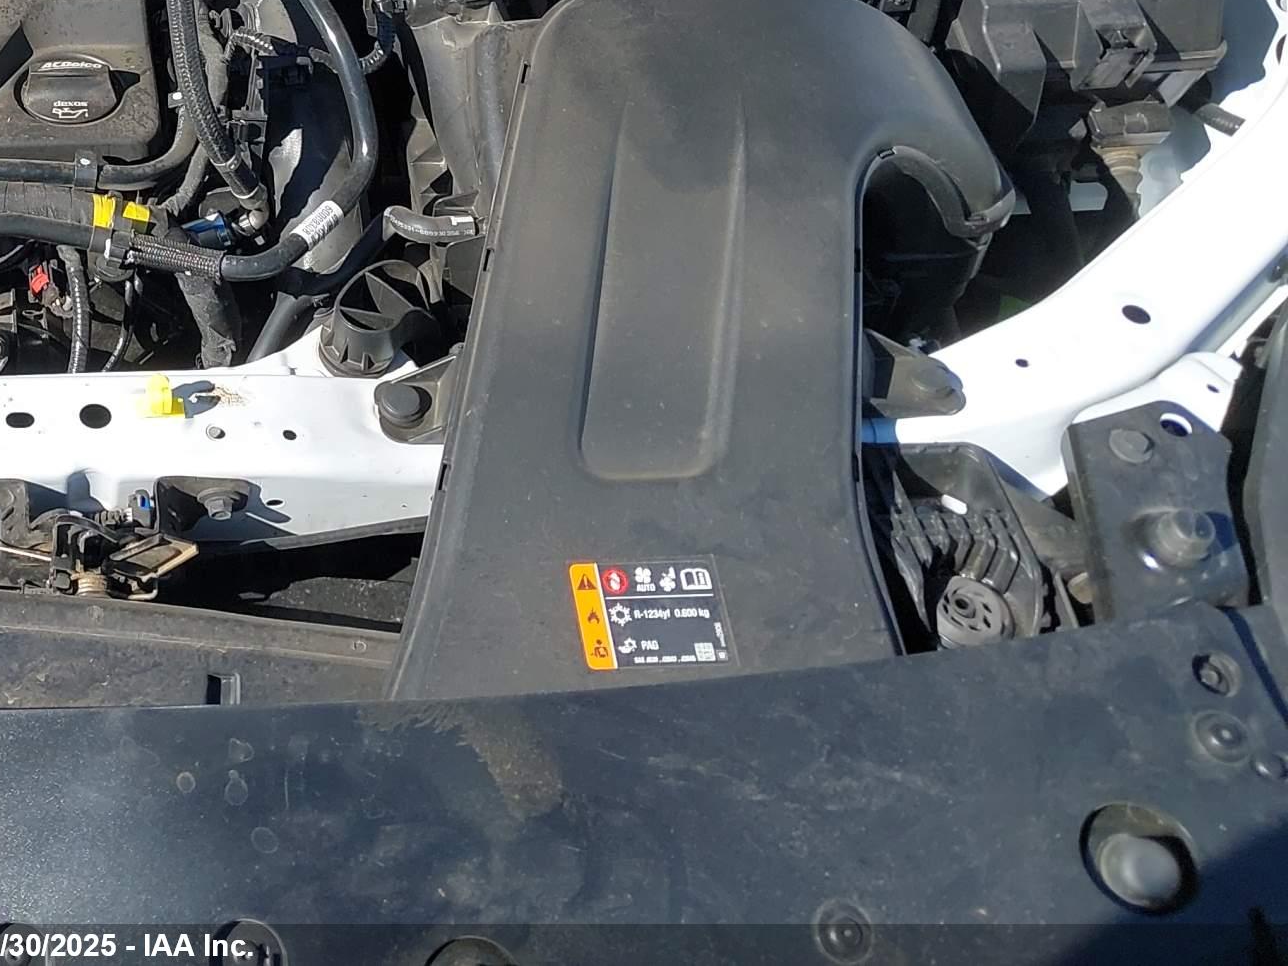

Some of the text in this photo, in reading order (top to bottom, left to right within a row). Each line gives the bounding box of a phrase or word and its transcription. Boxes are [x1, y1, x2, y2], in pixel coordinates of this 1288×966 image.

[38, 61, 103, 71] ACDelco
[53, 100, 89, 108] dexos
[636, 583, 656, 592] AUTO
[698, 608, 710, 619] kg
[641, 640, 660, 651] PAG
